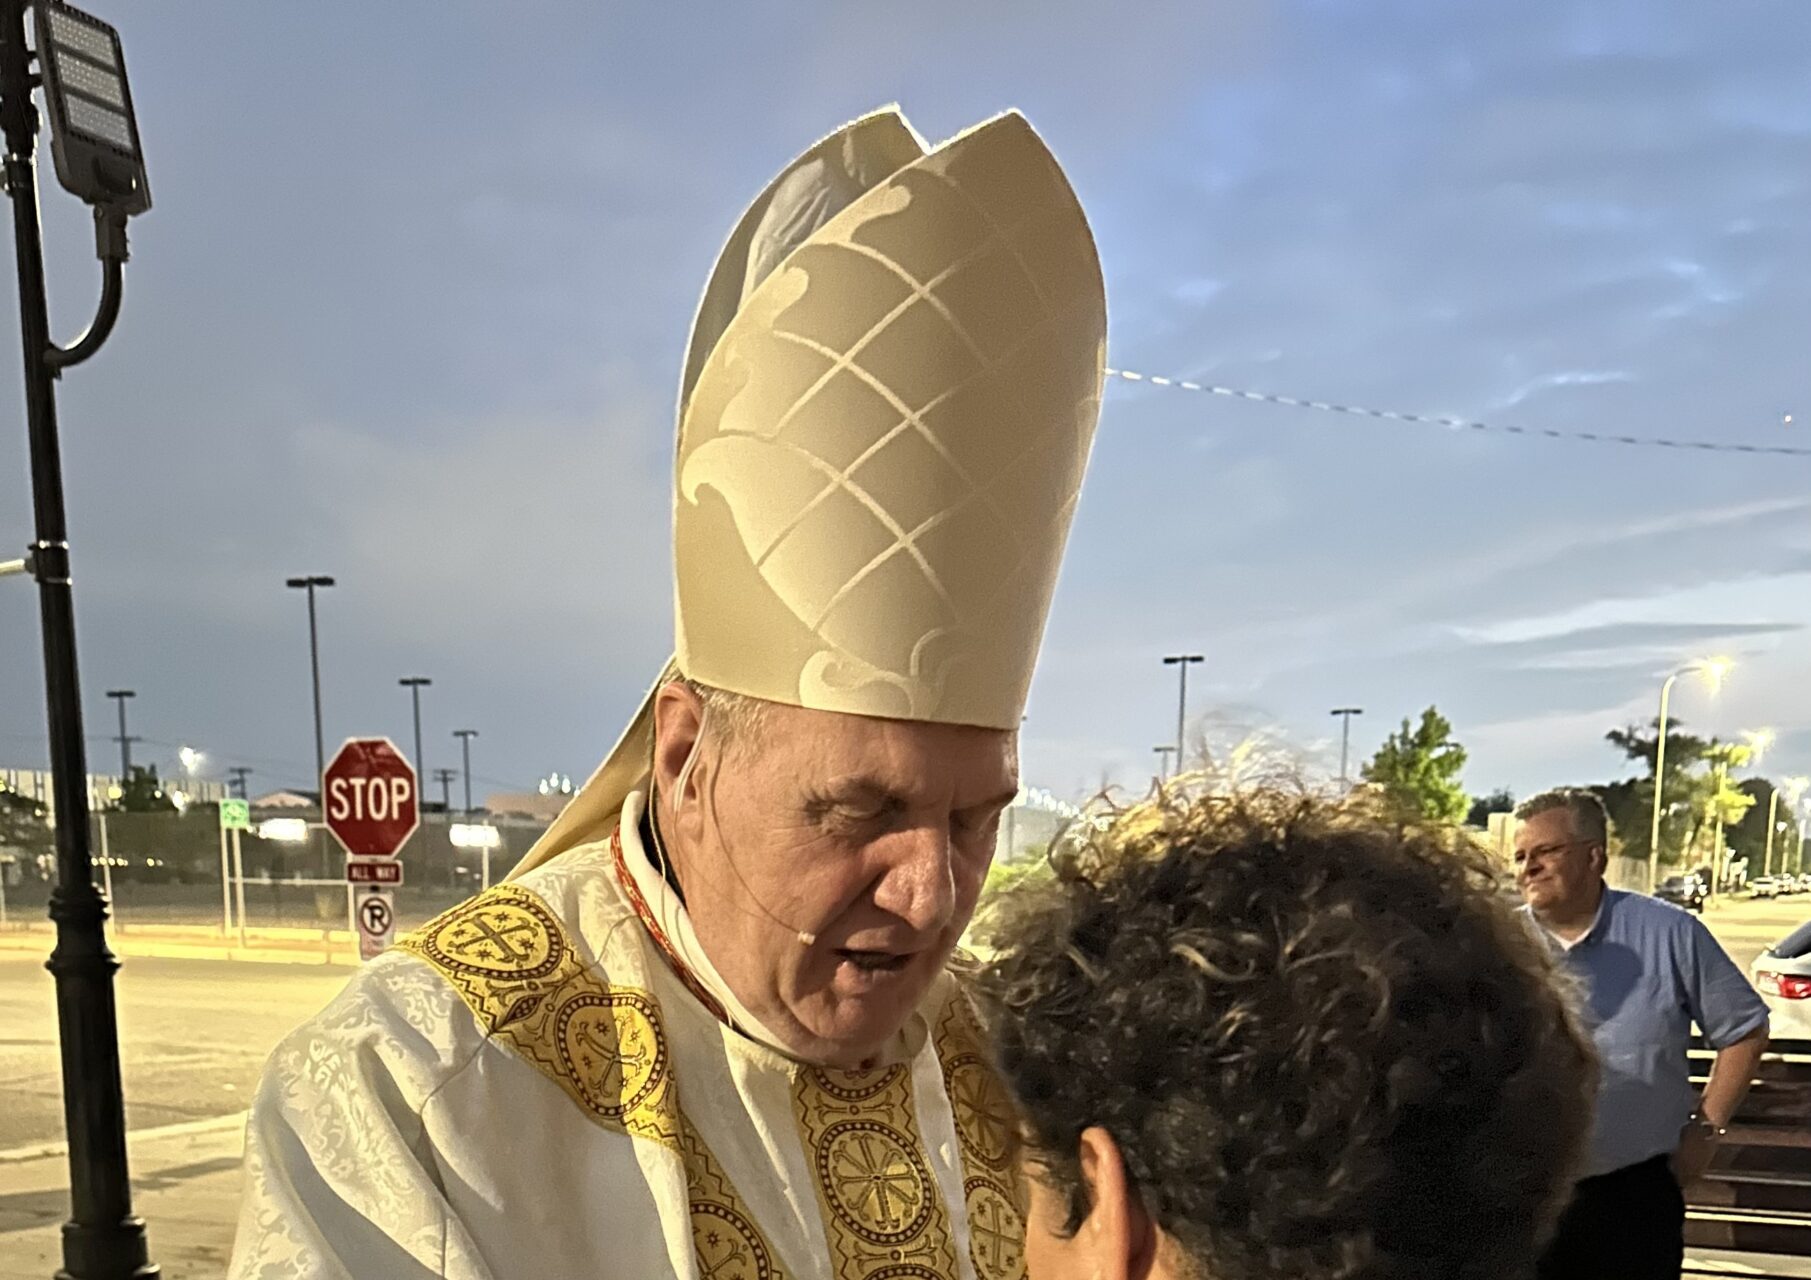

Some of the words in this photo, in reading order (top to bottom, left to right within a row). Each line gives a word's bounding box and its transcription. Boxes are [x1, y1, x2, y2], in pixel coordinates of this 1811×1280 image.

[330, 777, 411, 821] STOP
[351, 866, 370, 879] ALL
[375, 866, 397, 879] WAY
